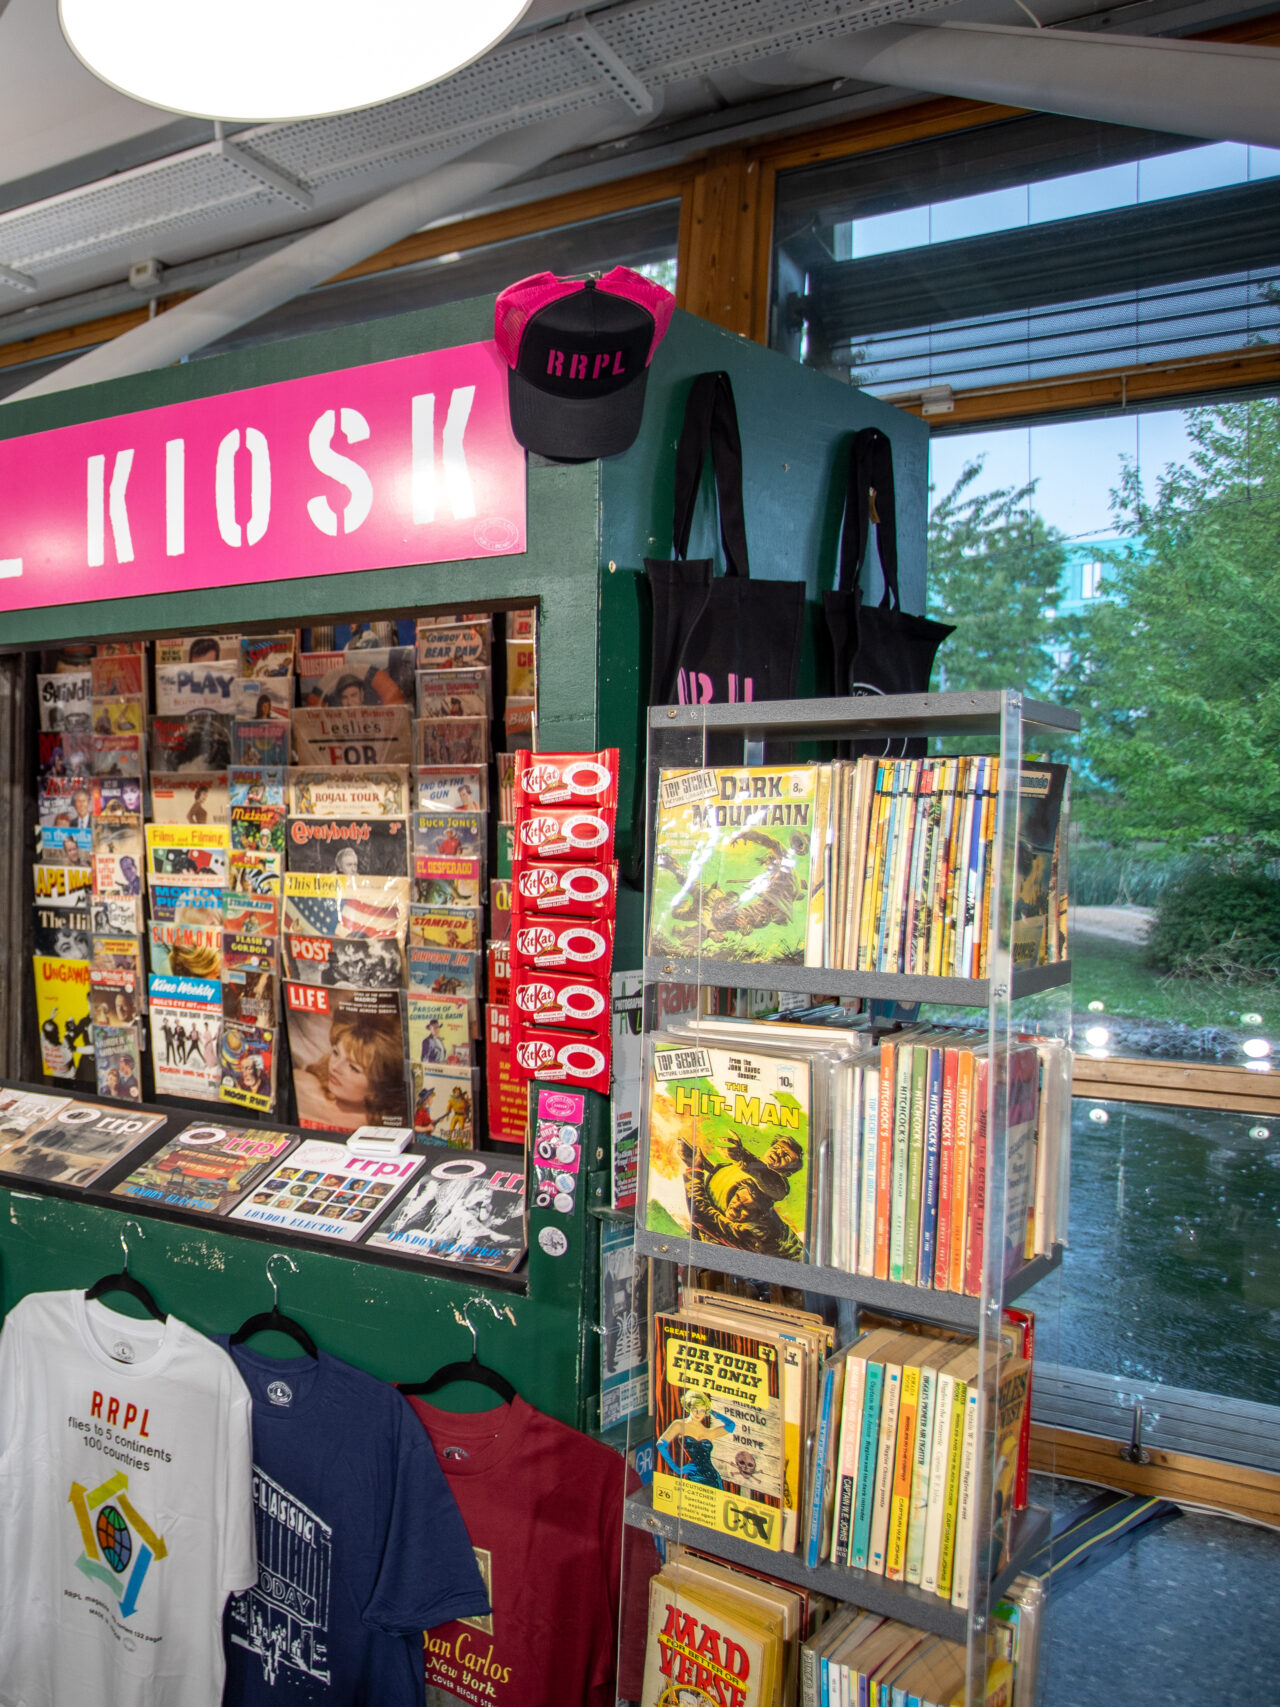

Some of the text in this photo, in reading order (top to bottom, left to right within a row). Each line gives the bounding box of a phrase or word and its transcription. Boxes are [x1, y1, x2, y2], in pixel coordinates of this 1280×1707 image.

[547, 349, 626, 379] RRPL
[87, 385, 476, 567] KIOSK
[177, 668, 234, 698] PLAY
[320, 720, 381, 736] Leslie's
[523, 765, 557, 791] KitKat
[664, 781, 680, 798] TOP
[720, 776, 782, 800] DARK
[792, 782, 803, 794] 8p
[315, 792, 380, 803] ROYAL TOUR
[430, 790, 449, 800] GUN
[419, 817, 477, 828] BUCK JONES
[692, 803, 810, 828] MOUNTAIN
[153, 830, 223, 847] Films Filming
[522, 818, 556, 844] KitKat
[417, 862, 473, 875] EL DESPERADO
[36, 867, 66, 898] APE
[287, 876, 311, 891] This
[520, 869, 554, 895] KitKat
[38, 911, 66, 929] The
[412, 917, 469, 930] STAMPEDE
[231, 943, 268, 955] GORDON
[236, 935, 263, 945] FLASH
[290, 940, 331, 961] POST
[518, 928, 552, 954] KitKat
[452, 953, 471, 965] JIM
[150, 978, 177, 994] Kine
[177, 980, 216, 1001] Weekly
[289, 986, 327, 1010] LIFE
[517, 984, 551, 1010] KitKat
[518, 1041, 552, 1067] KitKat
[656, 1050, 707, 1072] TOP SECRET
[729, 1057, 752, 1066] from the
[658, 1070, 678, 1078] PICTURE
[725, 1081, 749, 1093] THE
[778, 1076, 793, 1088] 10p
[675, 1085, 800, 1130] HIT-MAN
[880, 1080, 889, 1137] HITCHCOCK'S
[898, 1085, 908, 1143] HITCHCOCK'S
[912, 1090, 923, 1148] HITCHCOCK'S
[942, 1088, 952, 1146] HITCHCOCK'S
[957, 1088, 968, 1146] HITCHCOCK'S
[97, 1115, 157, 1136] rrpl
[928, 1094, 938, 1152] HITCHCOCK'S
[223, 1137, 291, 1158] rrpl
[344, 1157, 416, 1179] rrpl
[124, 1185, 217, 1211] LONDON ELECTRIC
[245, 1208, 345, 1236] LONDON ELECTRIC
[387, 1231, 504, 1257] LONDON ELECTRIC
[664, 1326, 707, 1341] GREAT PAN
[677, 1344, 758, 1375] FOR YOUR
[672, 1357, 762, 1389] EYES ONLY
[678, 1372, 758, 1404] Ian Fleming
[90, 1390, 151, 1439] RRPL
[724, 1406, 767, 1426] PERICOLO
[67, 1415, 173, 1463] flies to 5 continents
[733, 1433, 765, 1451] MORTE
[741, 1424, 751, 1434] DI
[83, 1436, 151, 1472] 100 countries
[252, 1477, 315, 1543] CLASSIC
[723, 1499, 775, 1545] 007
[840, 1479, 852, 1541] CAPTAIN JOHNS
[660, 1603, 750, 1683] MAD
[455, 1633, 512, 1684] Carlos
[666, 1637, 740, 1686] FOR BETTER OR
[426, 1656, 497, 1698] New York
[657, 1638, 747, 1707] VERSE
[432, 1674, 478, 1703] COVER BEFORE
